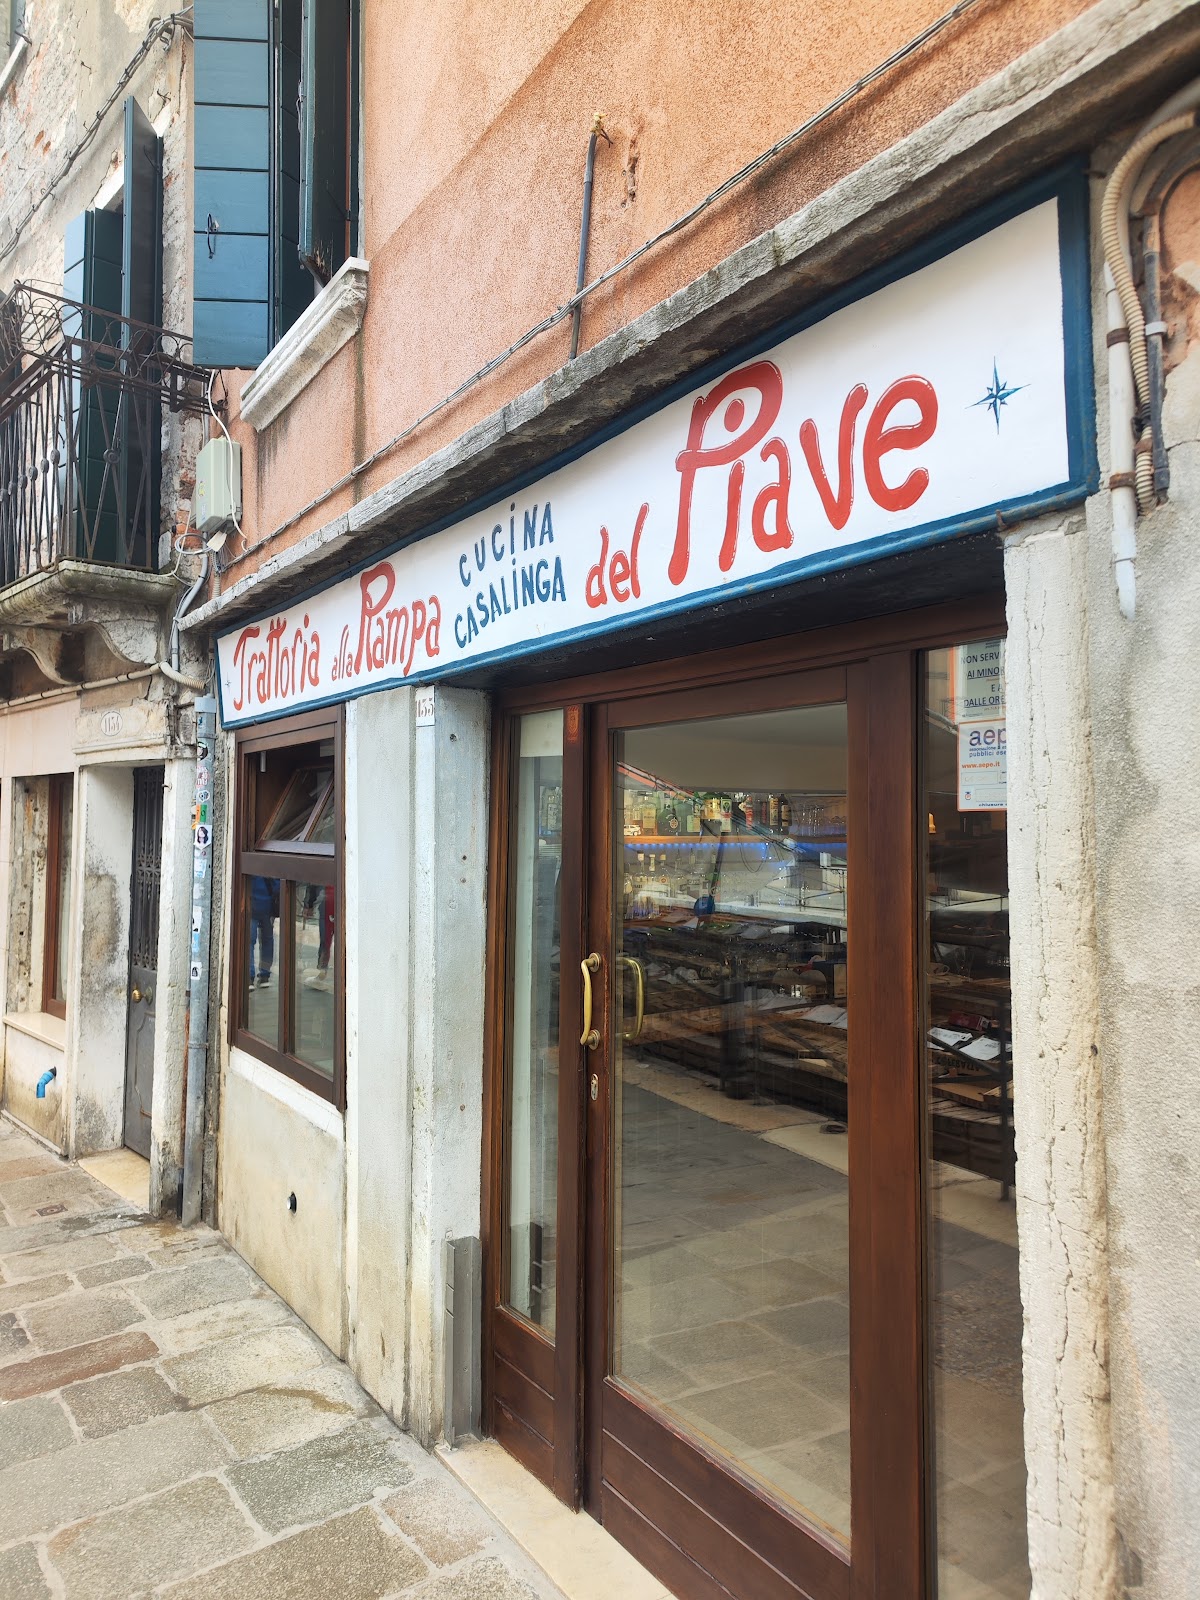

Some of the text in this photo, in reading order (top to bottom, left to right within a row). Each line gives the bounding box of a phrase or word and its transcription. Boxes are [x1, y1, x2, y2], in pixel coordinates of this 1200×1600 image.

[585, 360, 938, 608] del Piave
[233, 561, 442, 712] Trattoria alla Rampa
[991, 684, 996, 692] E
[963, 697, 987, 707] DALLE
[961, 761, 1000, 769] www.aepe.it
